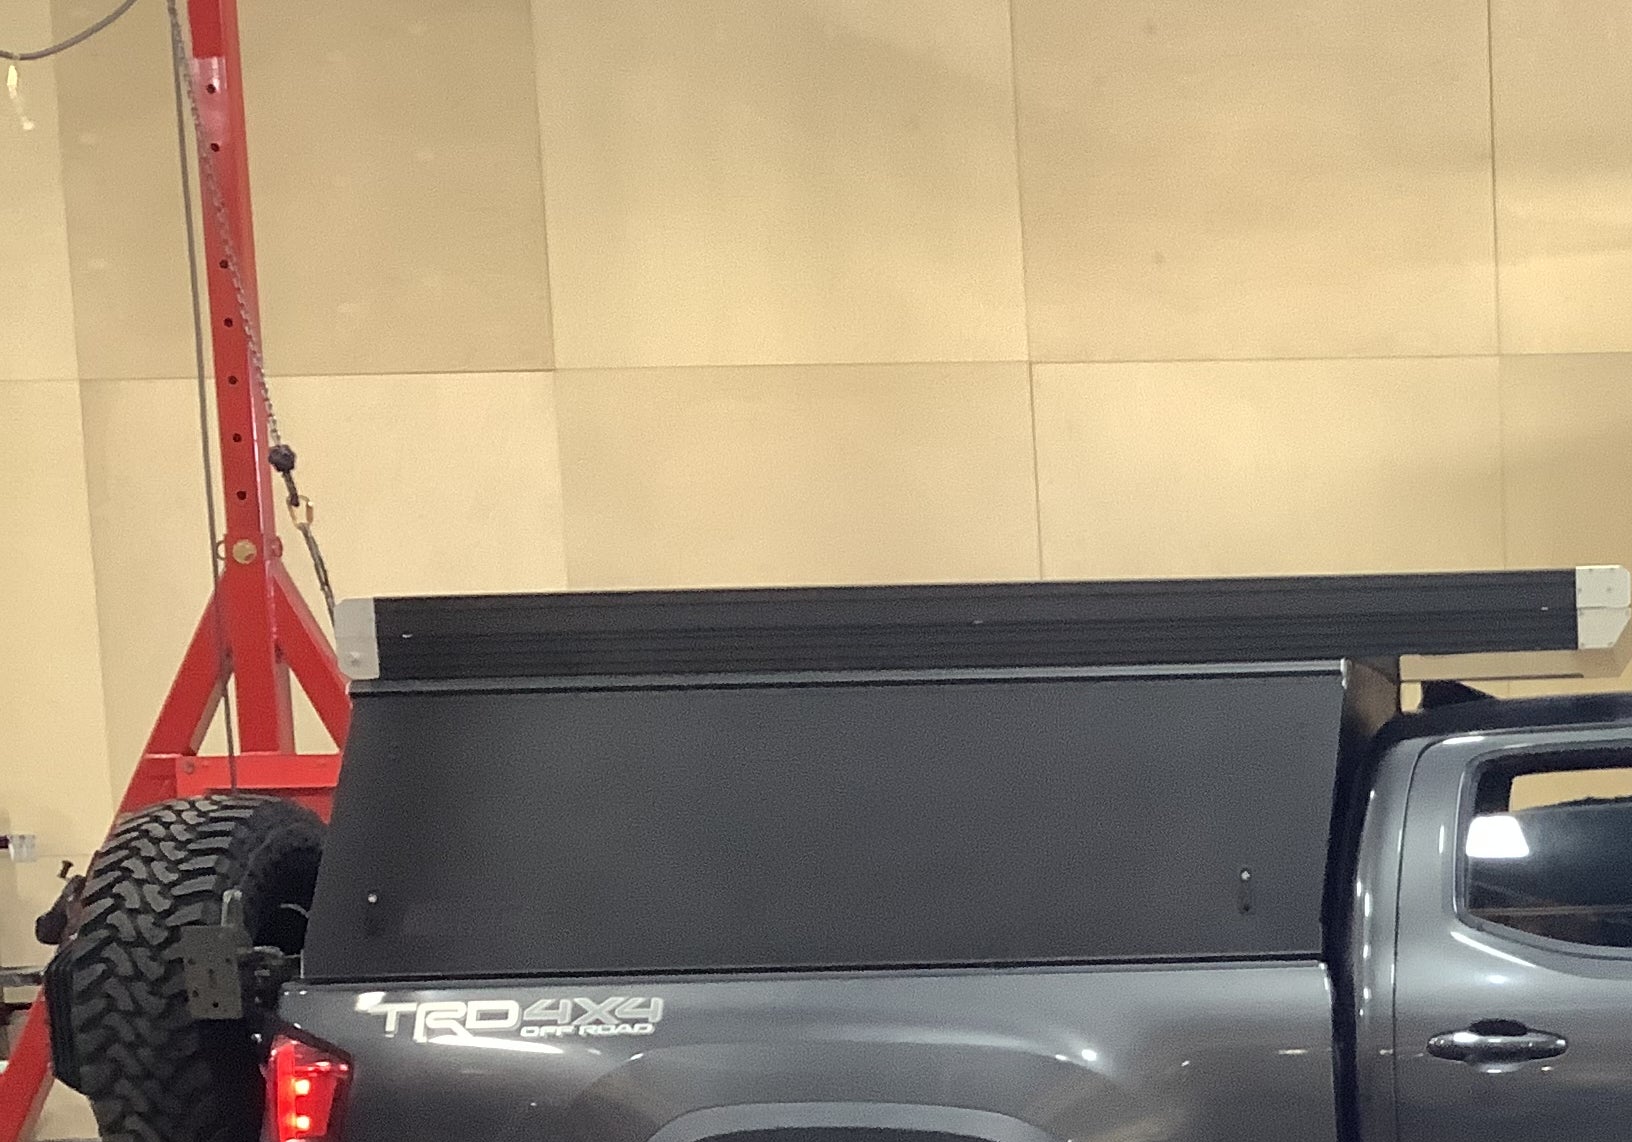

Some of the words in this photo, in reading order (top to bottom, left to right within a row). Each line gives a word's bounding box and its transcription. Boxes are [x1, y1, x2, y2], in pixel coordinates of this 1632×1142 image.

[367, 999, 522, 1043] TRD
[519, 1024, 573, 1038] OFF
[577, 1022, 655, 1037] ROAD
